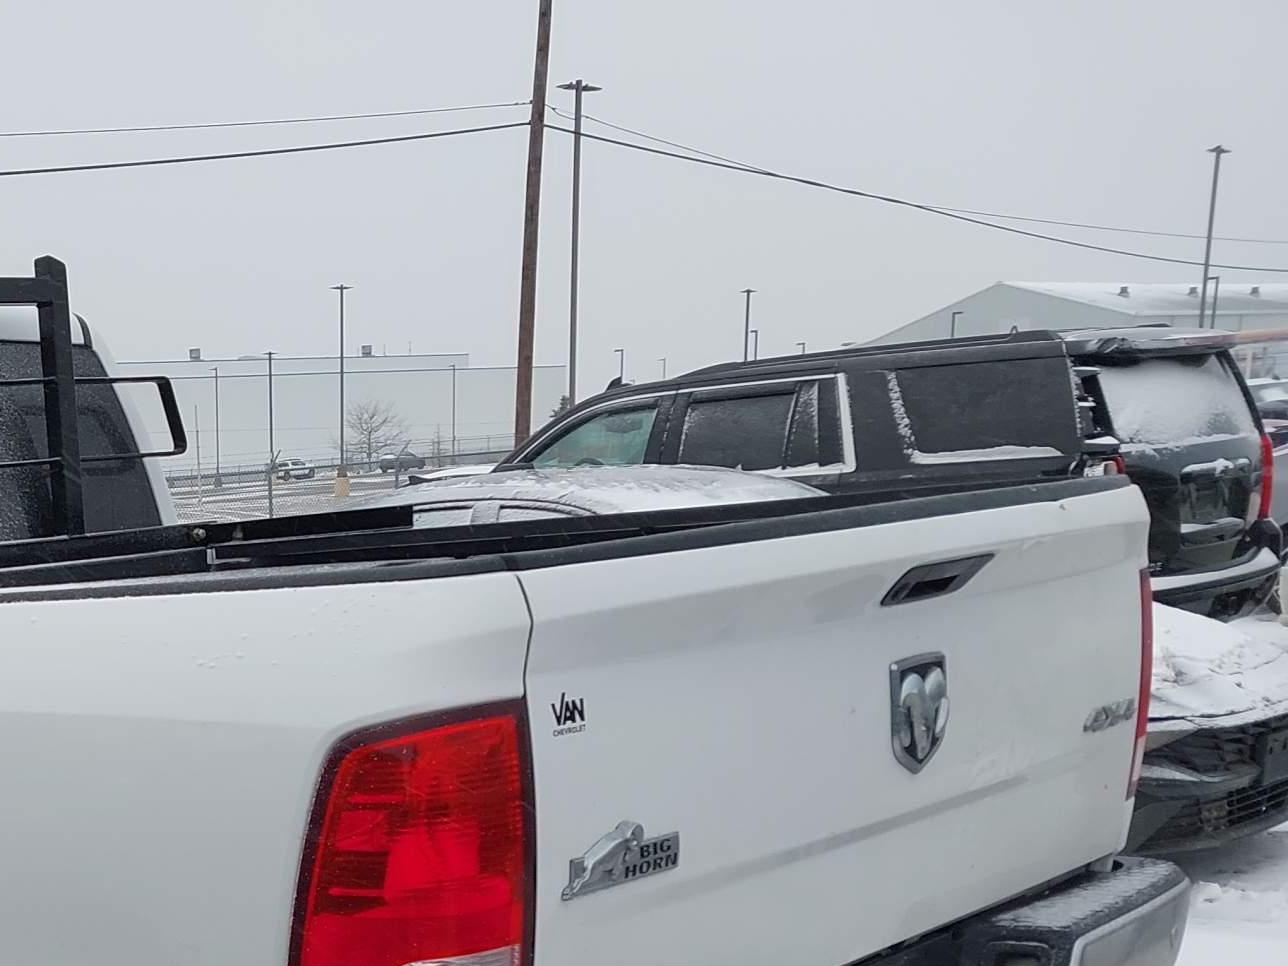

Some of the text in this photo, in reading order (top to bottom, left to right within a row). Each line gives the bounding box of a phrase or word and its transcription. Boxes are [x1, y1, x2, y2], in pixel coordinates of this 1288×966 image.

[550, 692, 586, 726] VAN
[552, 724, 586, 737] CHEVROLET
[639, 838, 672, 859] BIG
[624, 851, 678, 880] HORN
